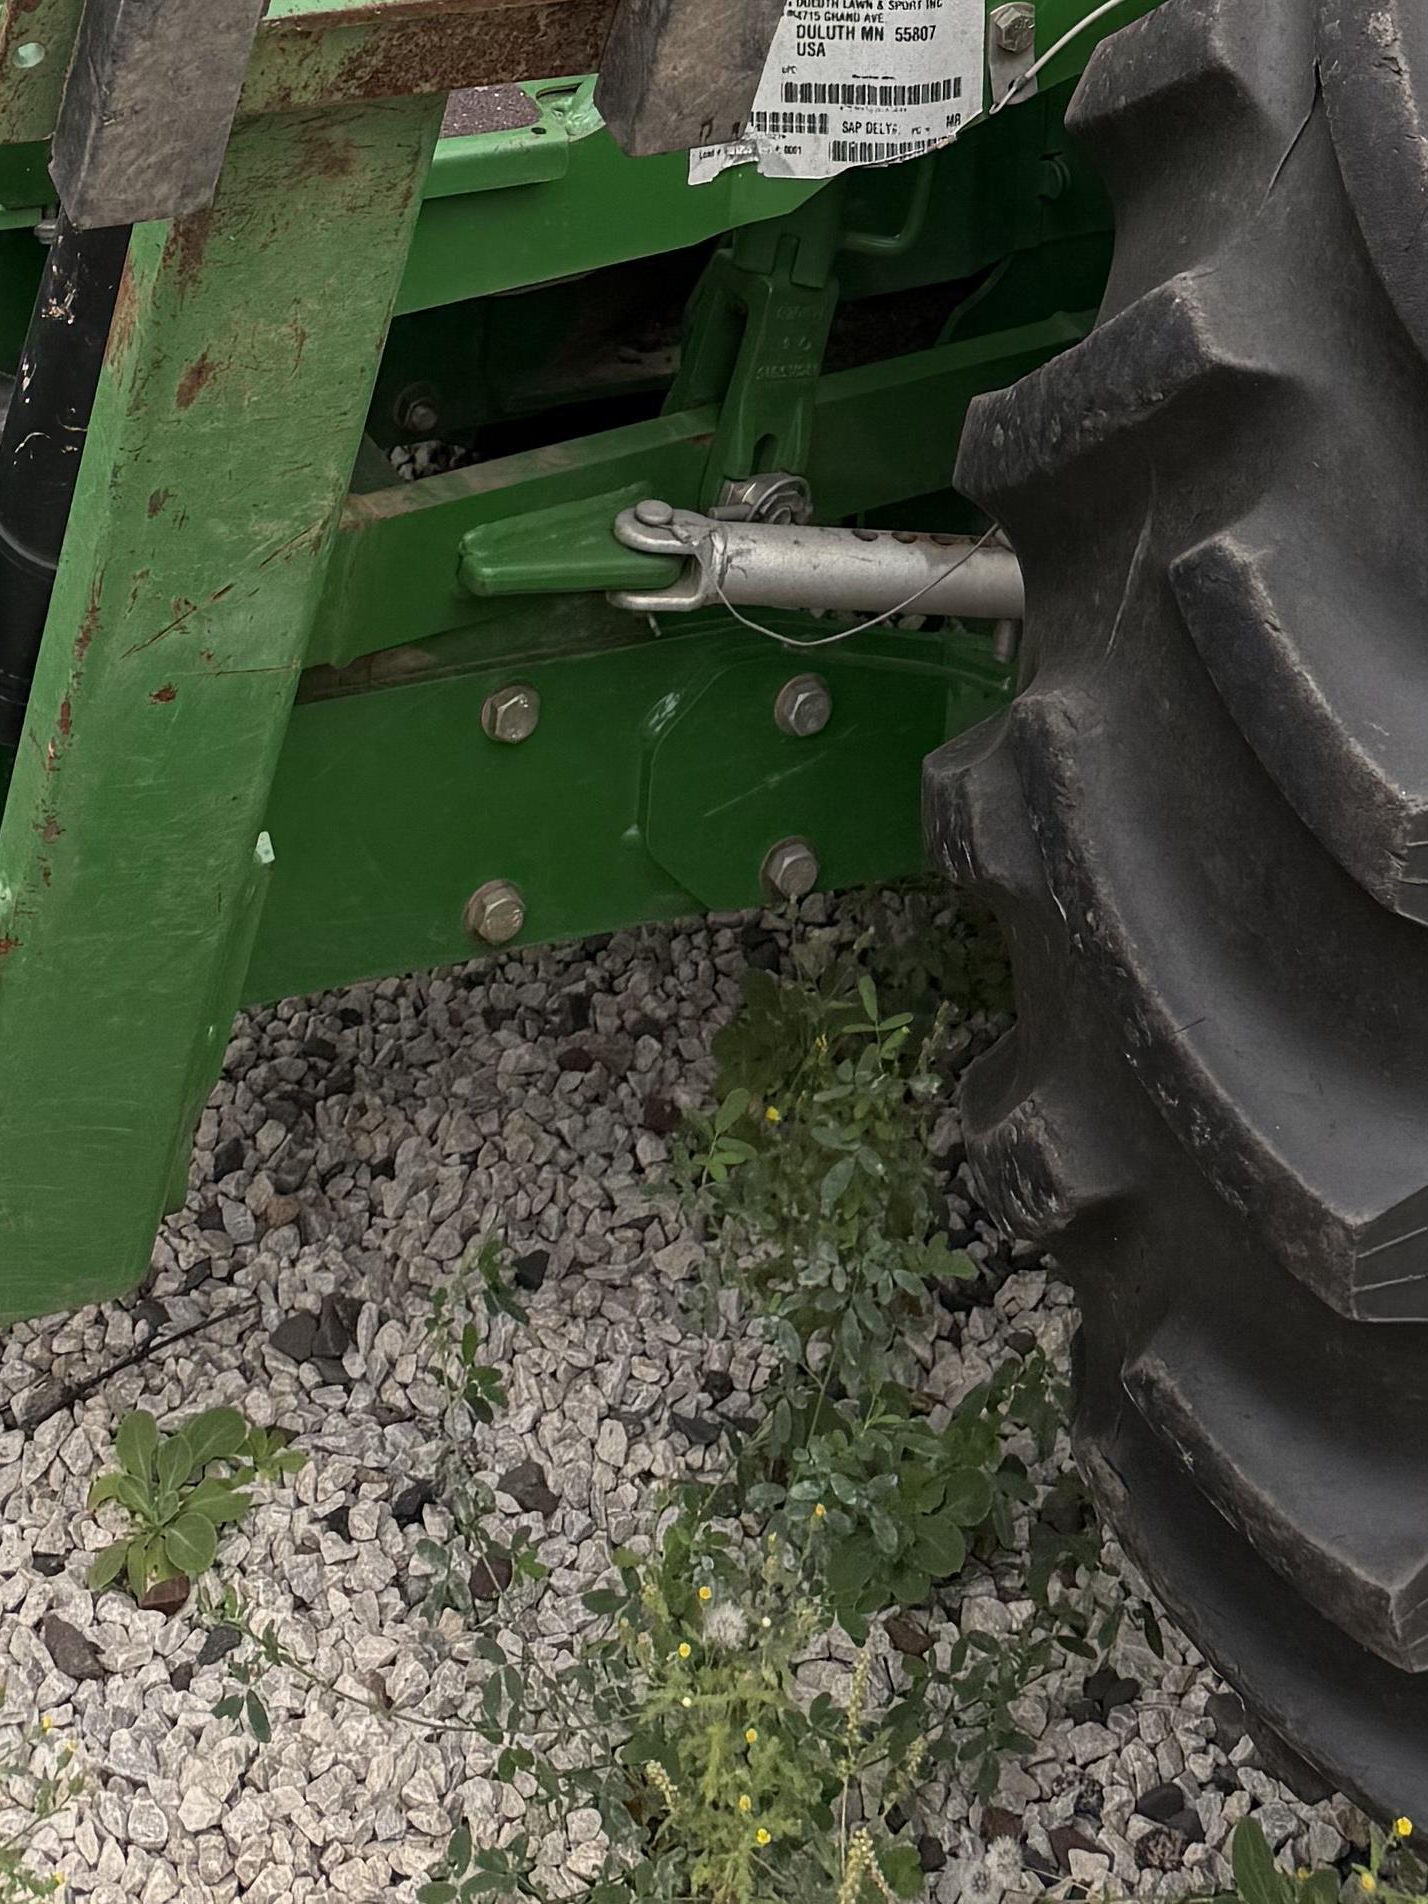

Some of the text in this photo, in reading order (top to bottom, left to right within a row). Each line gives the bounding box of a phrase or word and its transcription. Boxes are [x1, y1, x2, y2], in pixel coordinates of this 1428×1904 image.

[876, 0, 884, 10] &
[796, 24, 937, 42] DULUTH MN 55807
[796, 42, 826, 57] USA
[842, 121, 862, 134] SAP
